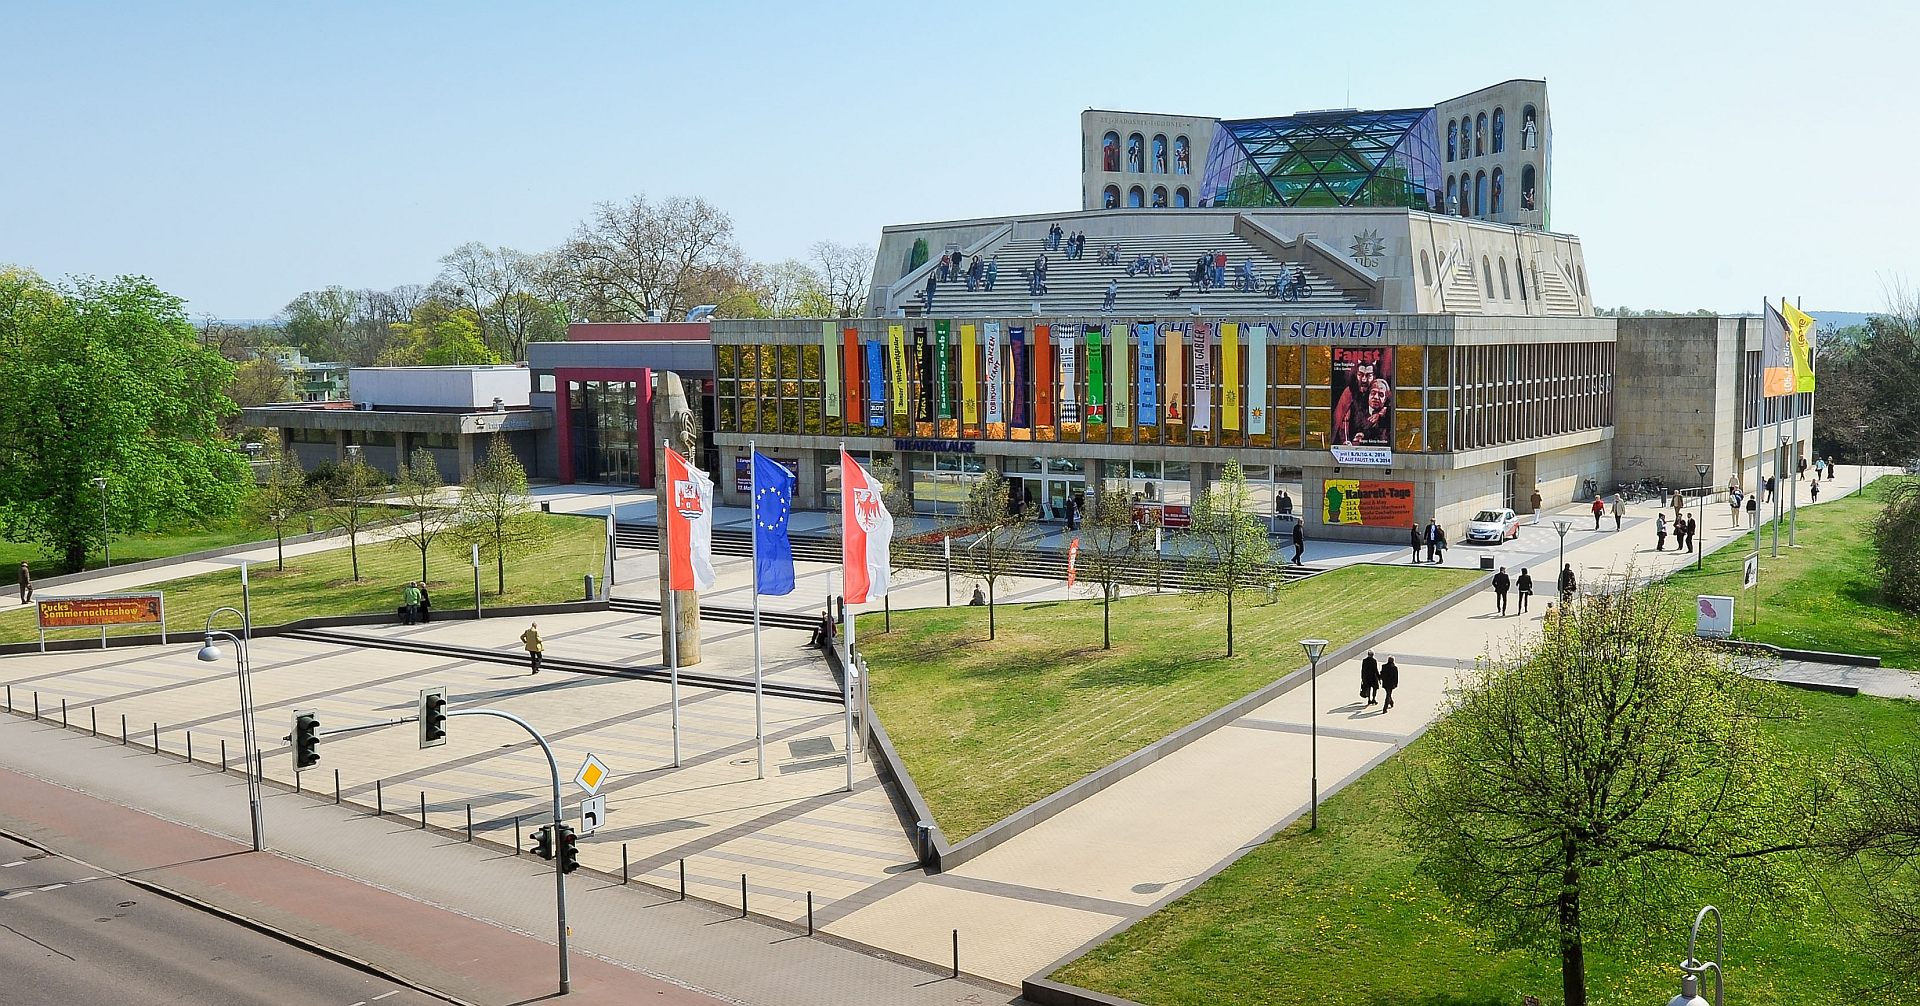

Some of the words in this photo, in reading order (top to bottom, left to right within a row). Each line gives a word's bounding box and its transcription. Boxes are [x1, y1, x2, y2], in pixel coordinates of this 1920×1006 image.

[1290, 321, 1388, 338] SCHWEDT
[988, 336, 996, 366] TANZEN
[1194, 329, 1205, 360] GABLER
[1334, 349, 1380, 361] Faust
[989, 360, 1001, 381] LERNT
[1195, 363, 1205, 390] HEDDA
[989, 384, 997, 415] ROBINSON
[1345, 488, 1411, 500] Kabarett-Tage
[40, 603, 69, 612] Pucks
[43, 607, 138, 619] Sommernachtsshow
